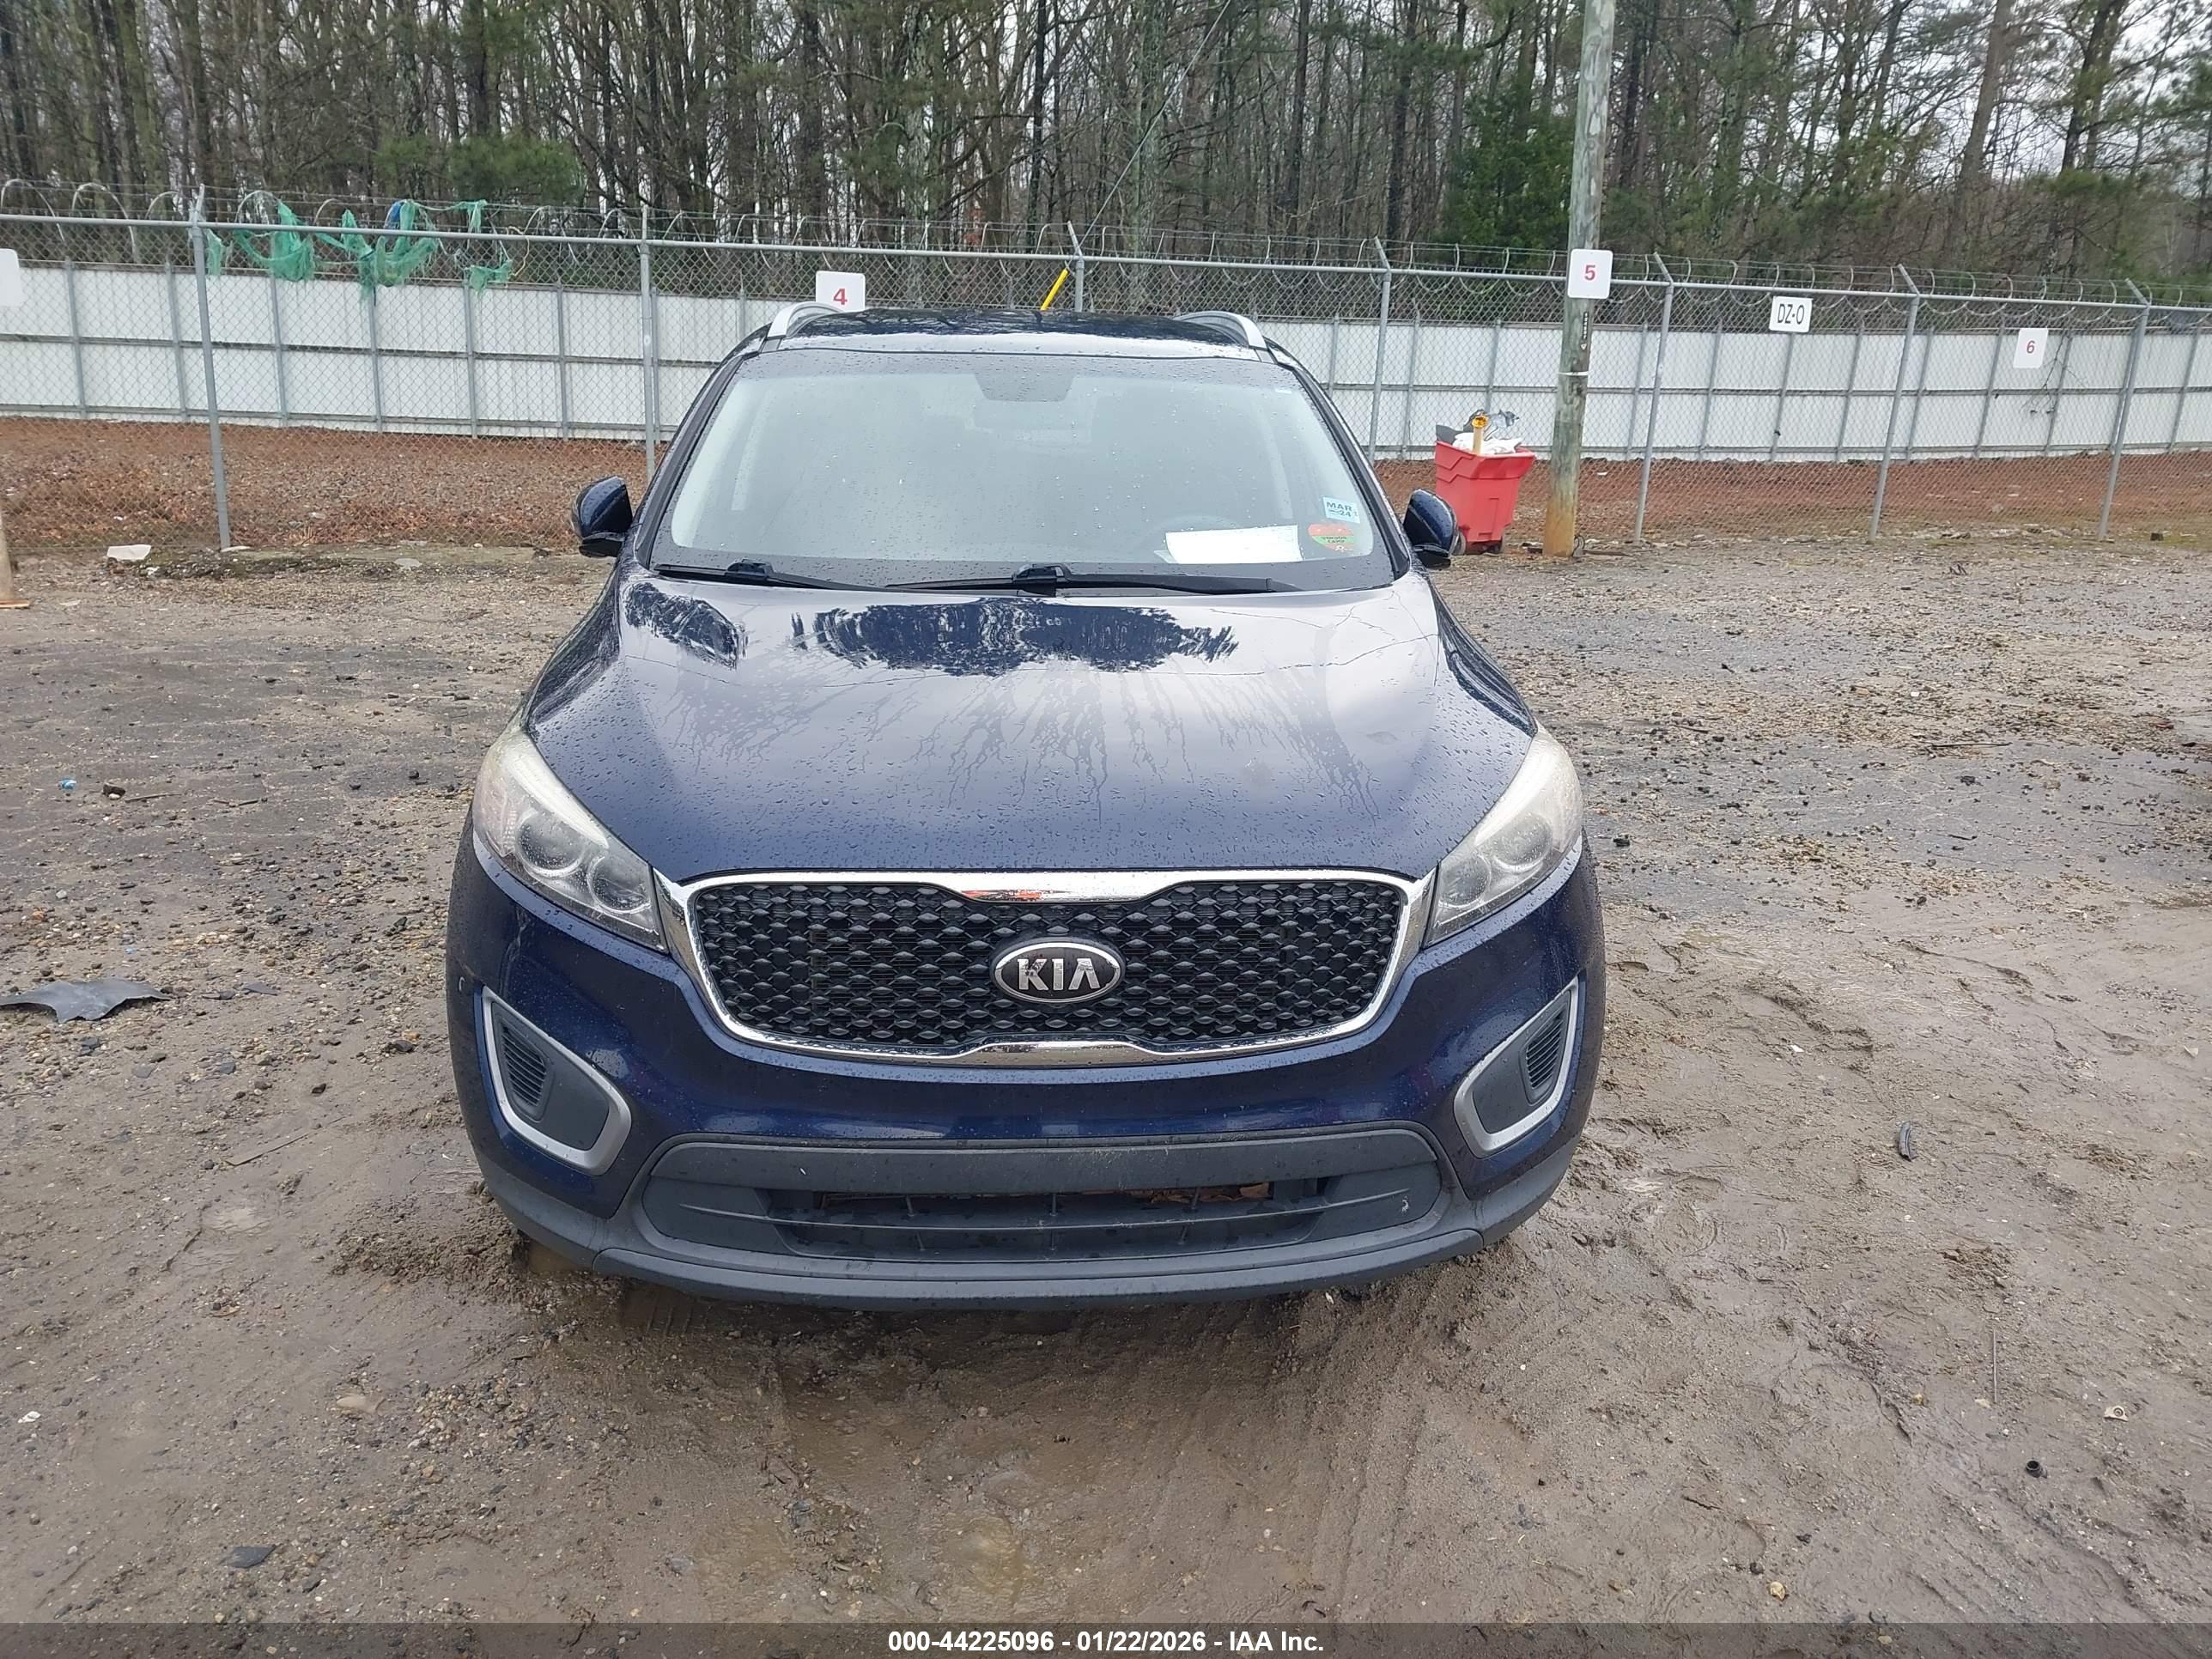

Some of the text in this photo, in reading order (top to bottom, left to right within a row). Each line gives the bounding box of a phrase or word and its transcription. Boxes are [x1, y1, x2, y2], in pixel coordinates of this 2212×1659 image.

[1584, 264, 1596, 281] 5
[833, 288, 848, 305] 4
[2027, 340, 2035, 354] 6
[1326, 501, 1352, 512] MAR
[1017, 958, 1101, 990] KIA
